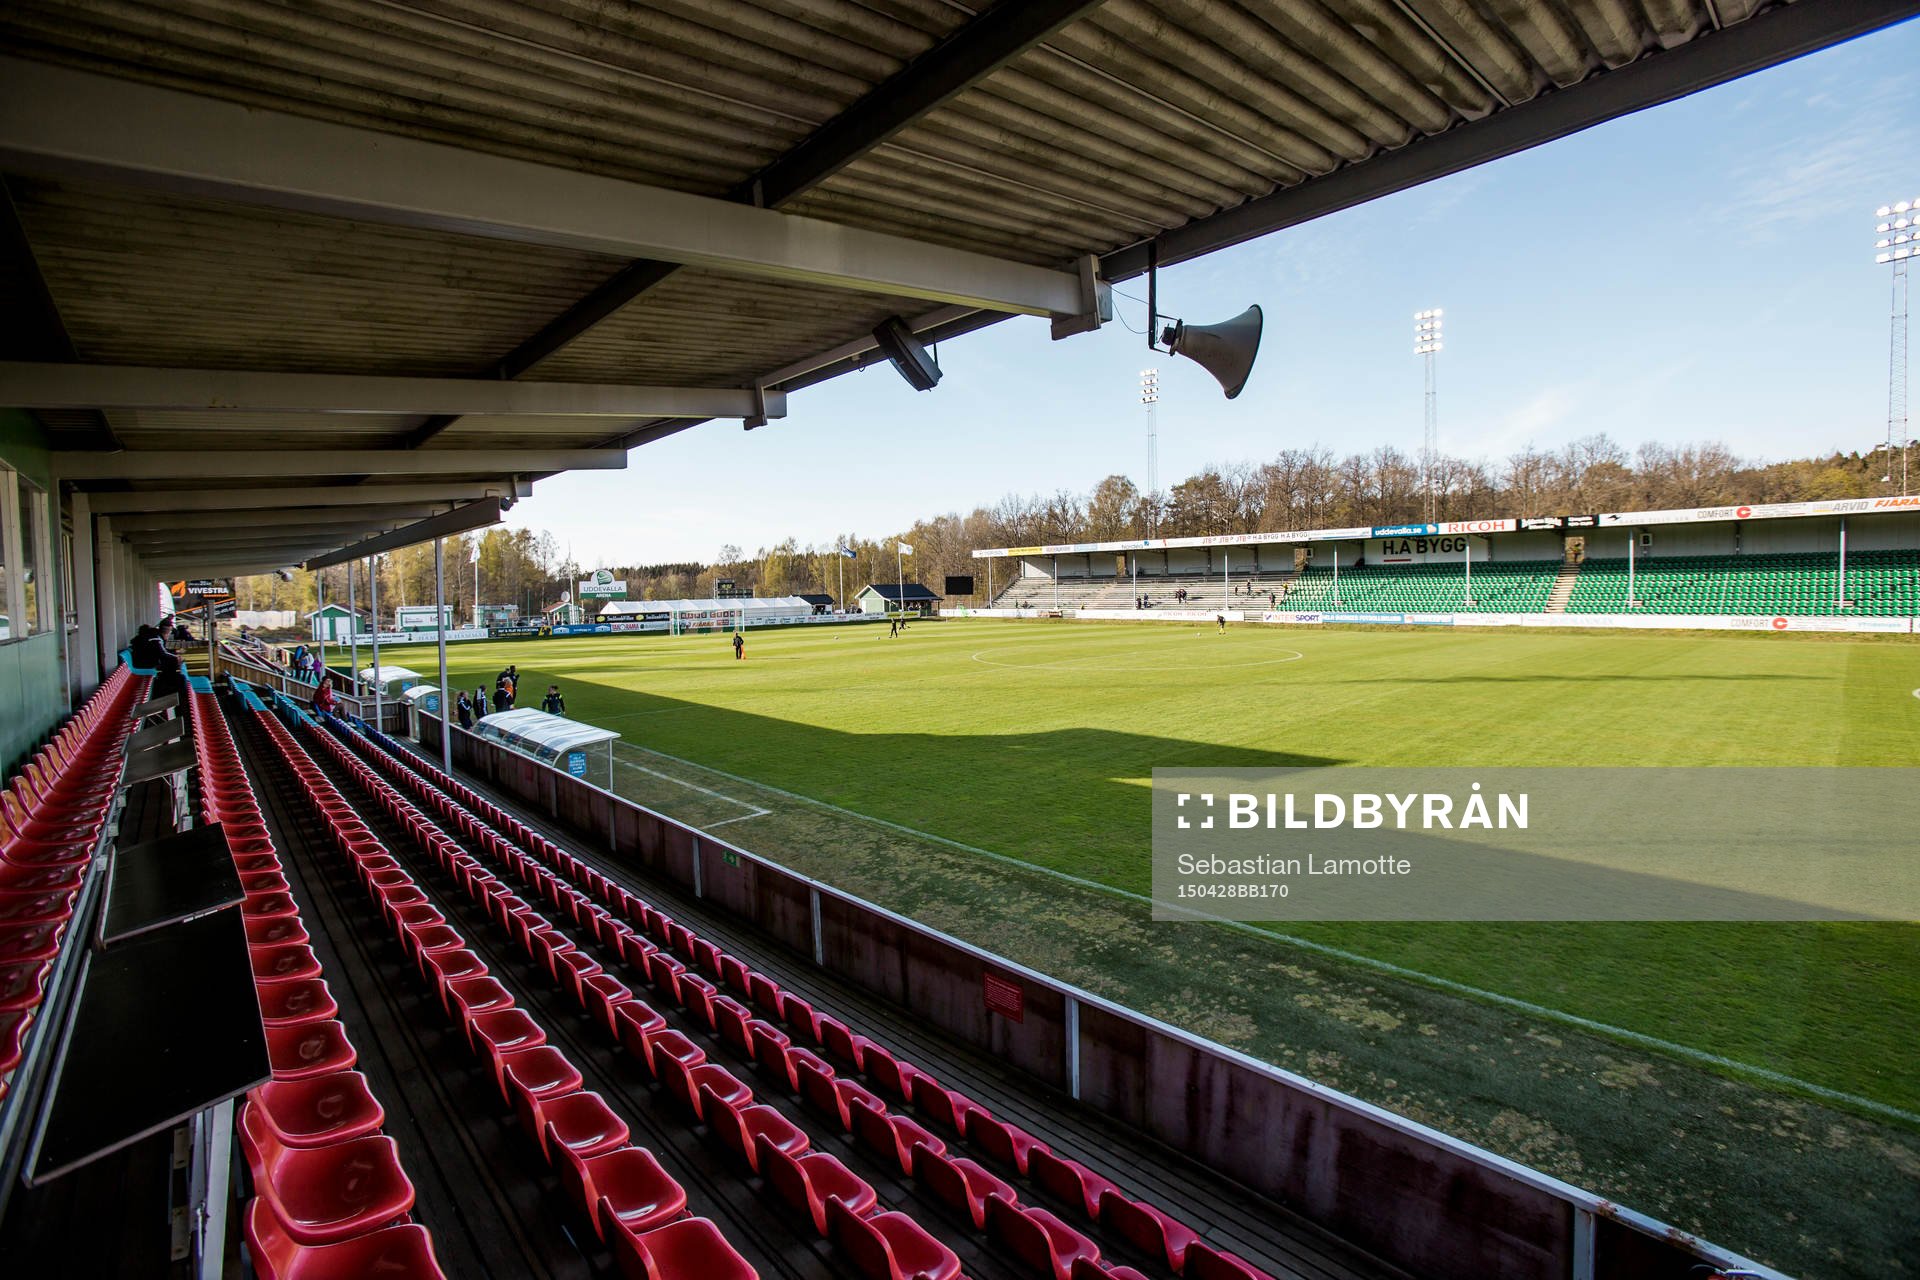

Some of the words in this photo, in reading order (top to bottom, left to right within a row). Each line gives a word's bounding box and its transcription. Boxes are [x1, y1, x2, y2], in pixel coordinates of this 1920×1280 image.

[1697, 508, 1733, 520] COMFORT
[1375, 527, 1422, 536] uddevalla.se
[1448, 521, 1505, 533] RICOH
[1383, 540, 1411, 555] H.A
[1416, 537, 1466, 554] BYGG
[187, 587, 229, 595] VIVESTRA
[1273, 614, 1320, 622] INTERSPORT
